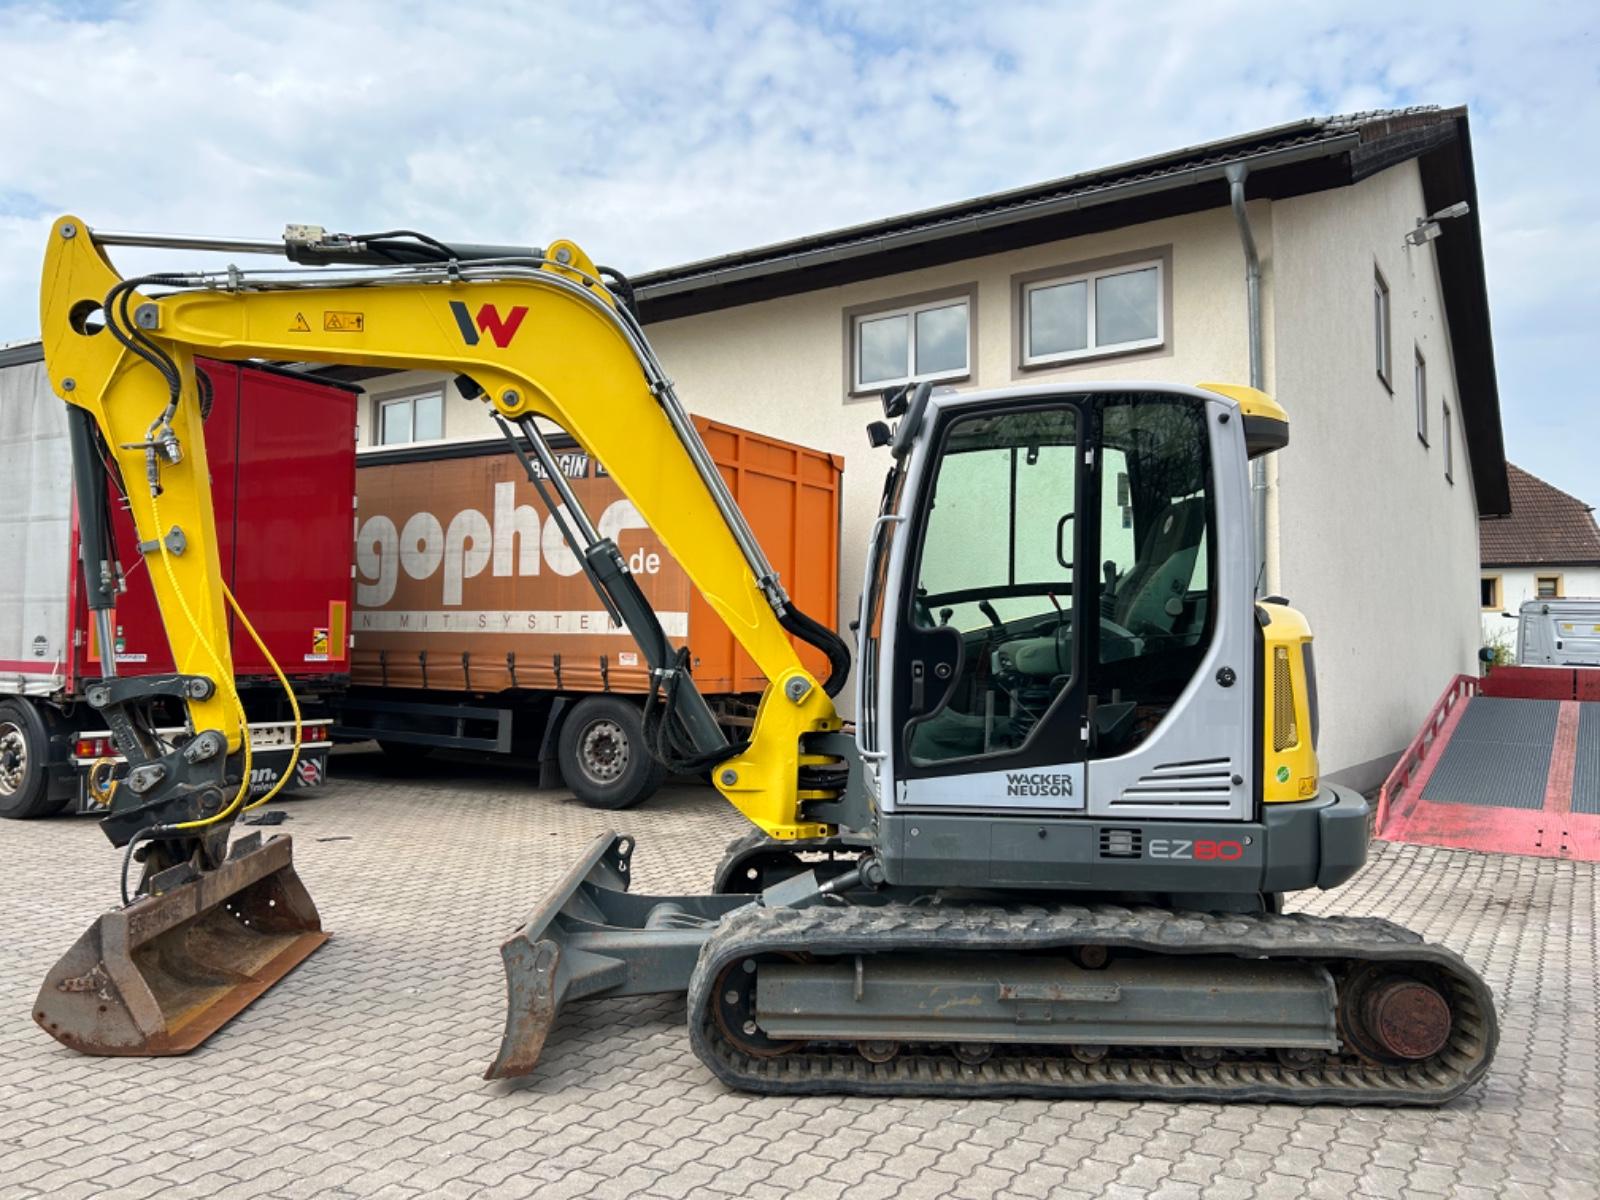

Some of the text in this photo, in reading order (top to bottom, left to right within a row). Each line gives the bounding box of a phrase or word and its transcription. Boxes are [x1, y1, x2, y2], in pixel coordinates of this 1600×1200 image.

[400, 614, 450, 628] MIT
[1006, 773, 1072, 785] WACKER
[1007, 785, 1073, 797] NEUSON
[1148, 839, 1243, 860] EZ80
